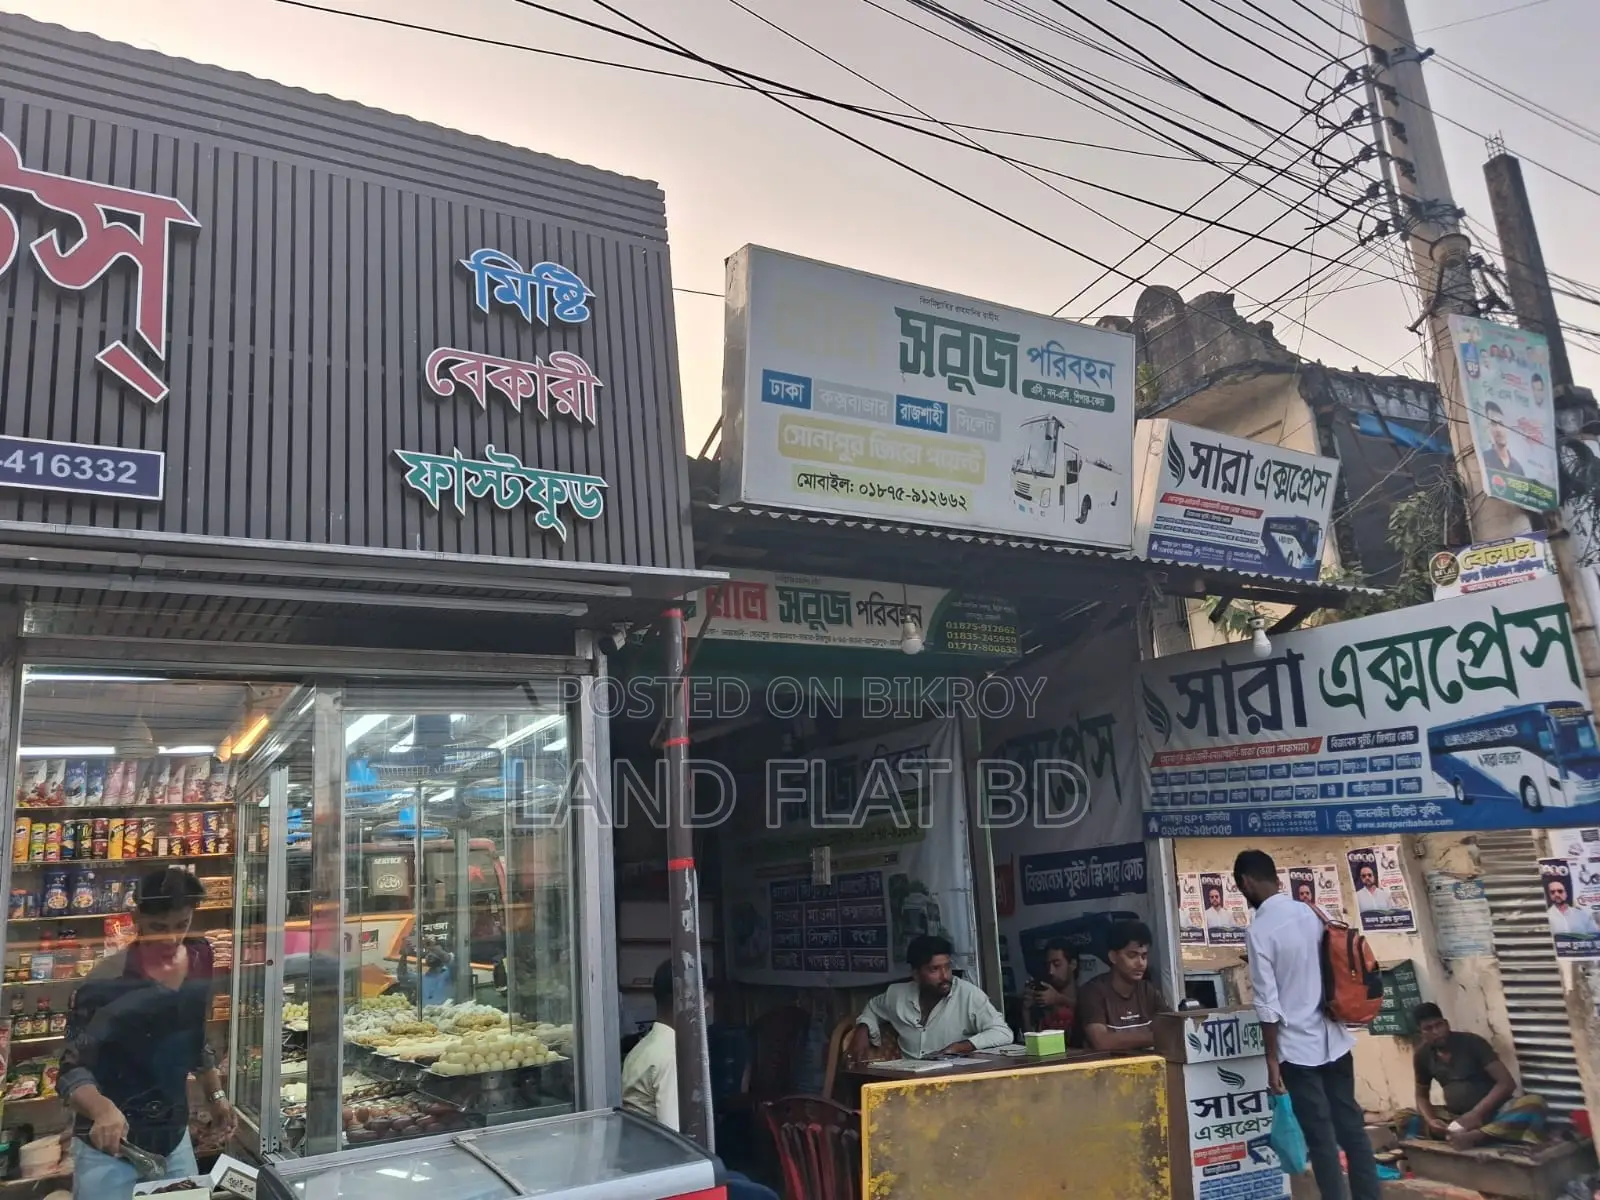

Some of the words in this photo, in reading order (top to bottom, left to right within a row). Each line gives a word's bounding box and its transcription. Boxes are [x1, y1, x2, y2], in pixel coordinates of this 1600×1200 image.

[459, 247, 597, 326] মিষ্টি
[894, 306, 1020, 396] সবুজ
[1027, 340, 1116, 390] পরিবহন
[425, 346, 604, 426] বেকারী
[768, 378, 805, 402] ঢাকা
[818, 388, 889, 418] কক্সবাজার
[899, 402, 944, 427] রাজশাহী
[955, 407, 996, 435] সিলেট
[783, 424, 864, 462] সোনাপুর
[394, 445, 609, 542] ফাস্টফুড
[797, 472, 855, 494] মোবাইল:
[859, 482, 968, 511] ০১৮৭৫-৯১২৬৬২
[1189, 441, 1254, 496] সারা
[1254, 458, 1332, 510] এক্সপ্রেস
[1461, 542, 1536, 570] বেলাল
[775, 585, 852, 632] সবুজ
[855, 591, 923, 629] পরিবহন
[1169, 648, 1307, 737] সারা
[1318, 603, 1583, 718] এক্সপ্রেস
[1025, 864, 1064, 895] বিজনেস
[1120, 857, 1144, 883] কোচ
[1203, 1016, 1241, 1057] সারা
[1190, 1087, 1272, 1119] সারা
